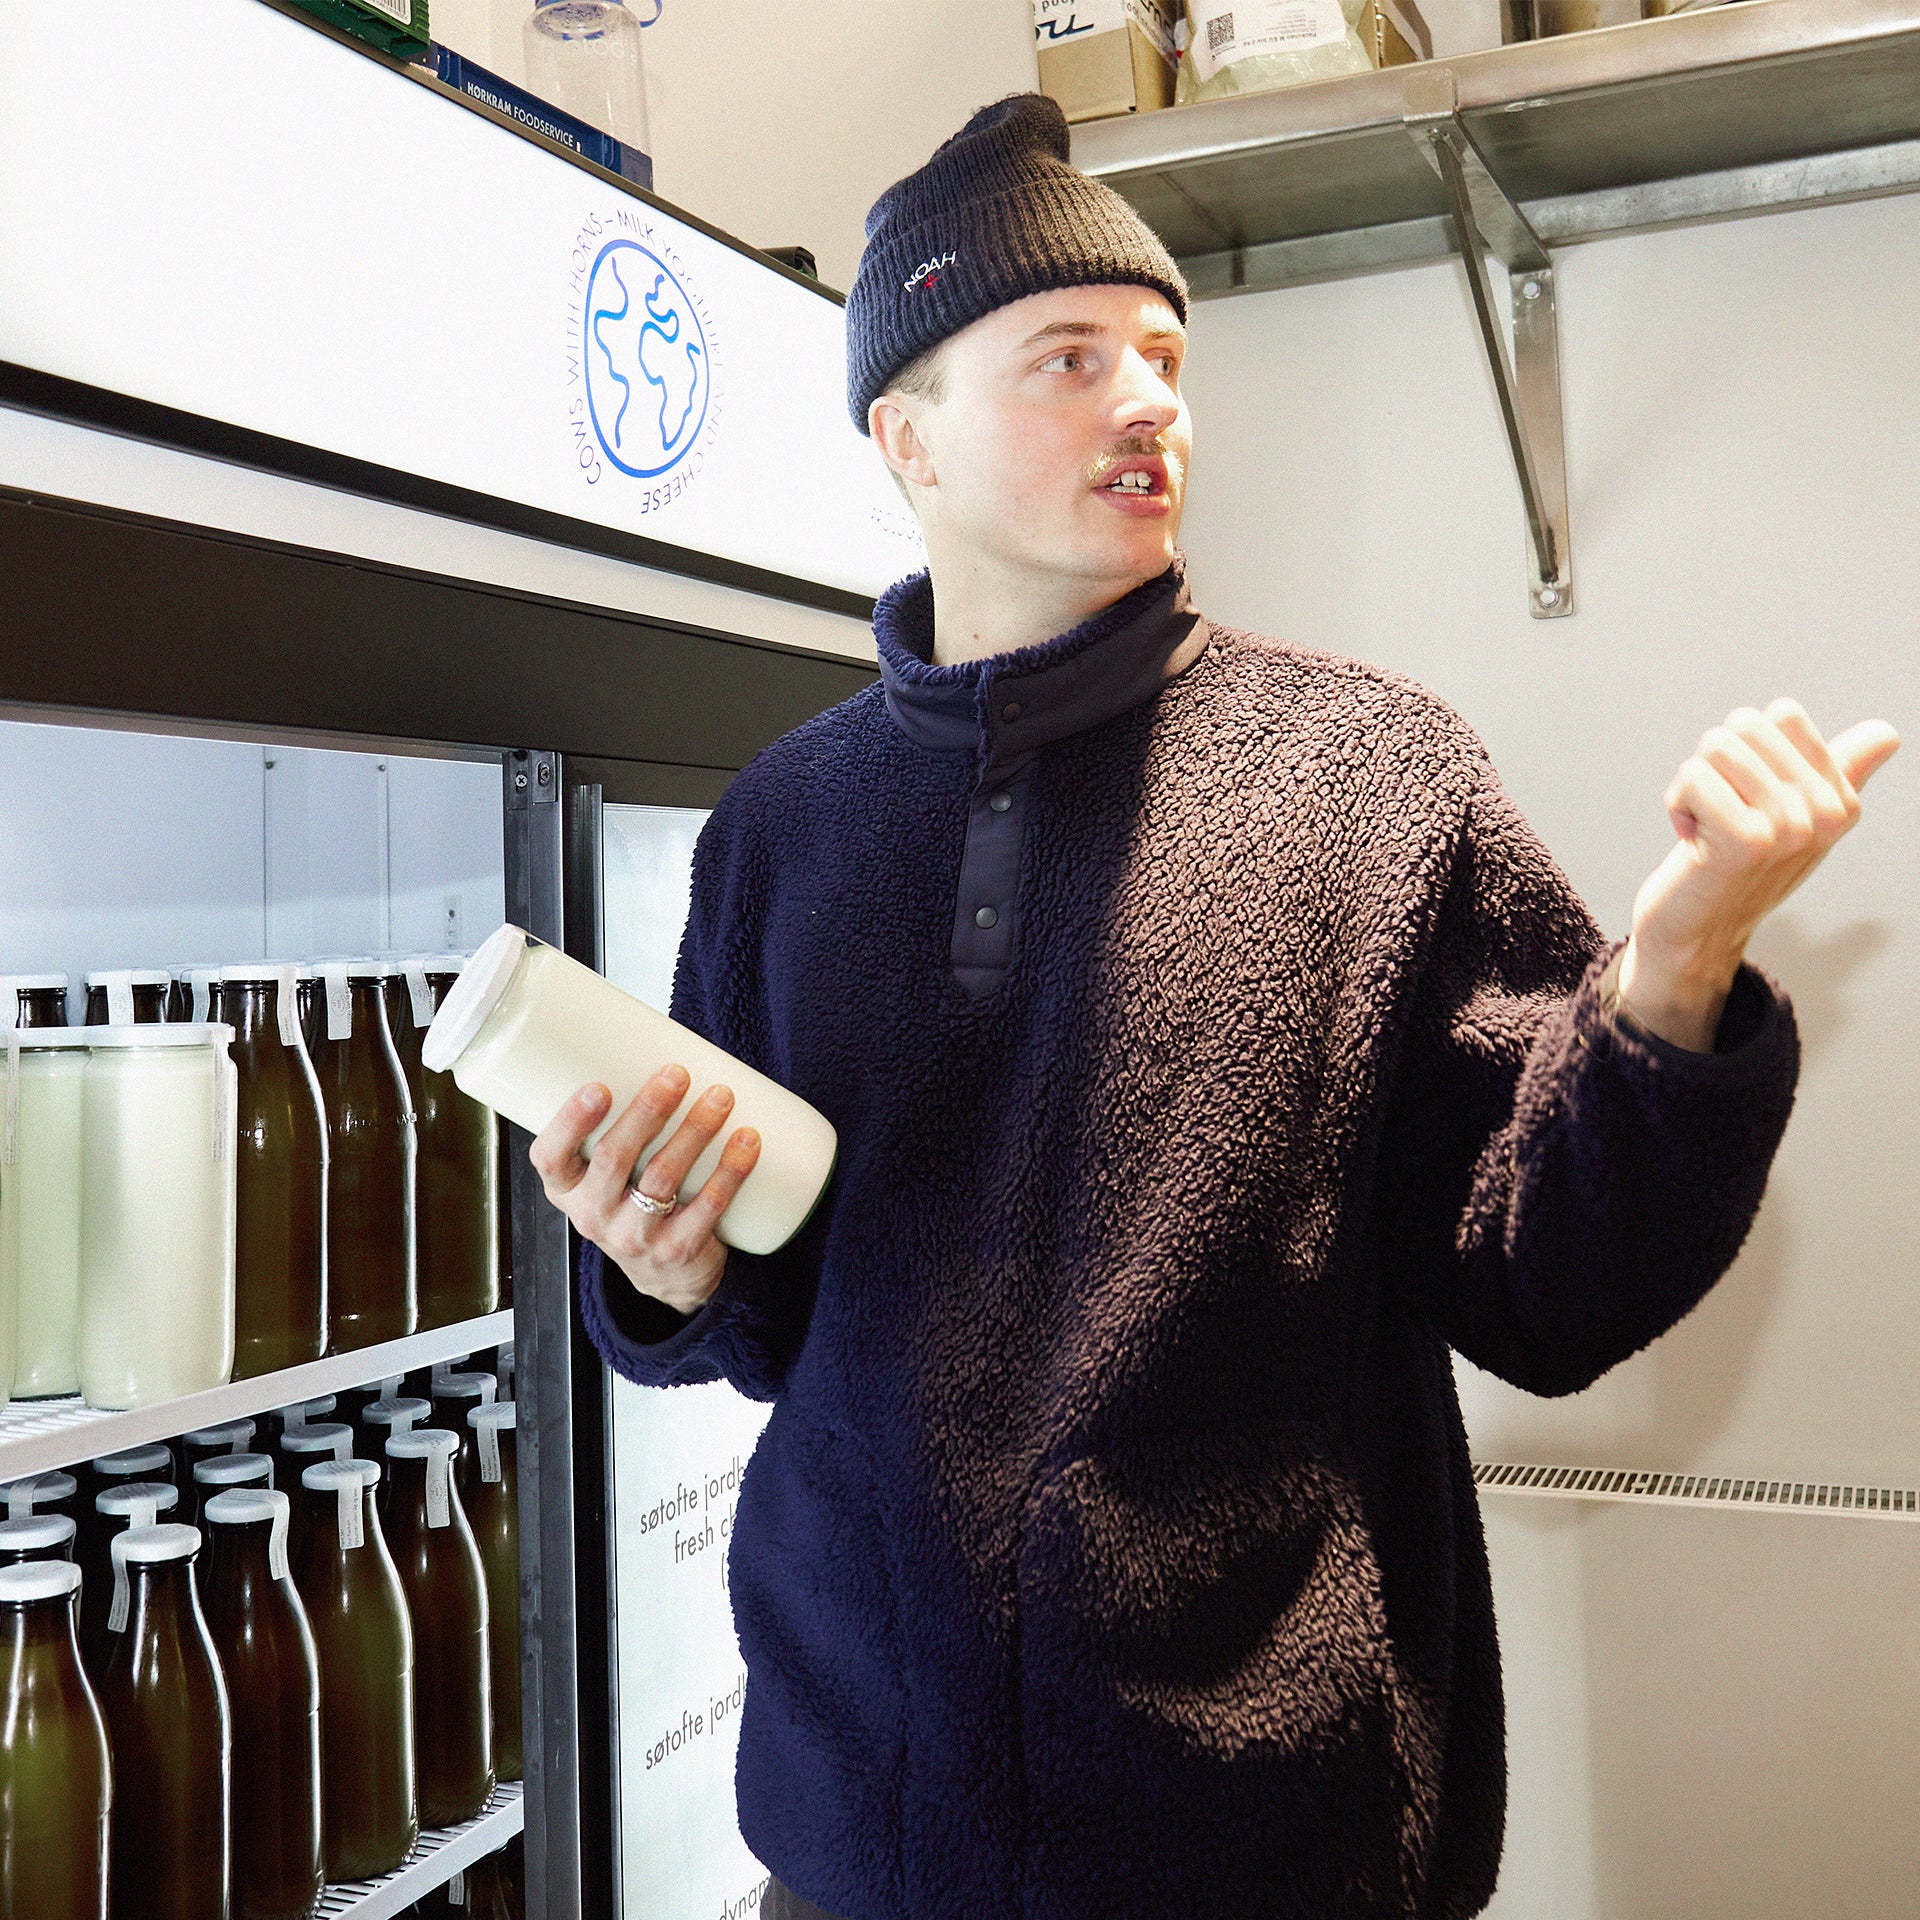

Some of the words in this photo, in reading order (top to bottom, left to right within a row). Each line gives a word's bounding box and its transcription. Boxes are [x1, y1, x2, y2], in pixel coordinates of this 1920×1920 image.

[467, 81, 512, 116] HØRKRAM
[513, 106, 574, 148] FOODSERVICE
[568, 212, 603, 295] HORNS
[616, 208, 656, 248] MILK
[903, 250, 957, 293] NOAH
[565, 302, 580, 386] WITH
[568, 398, 602, 486] COWS
[640, 451, 705, 515] CHEESE
[640, 1482, 699, 1535] søtofte
[674, 1529, 714, 1564] fresh
[645, 1709, 704, 1771] søtofte
